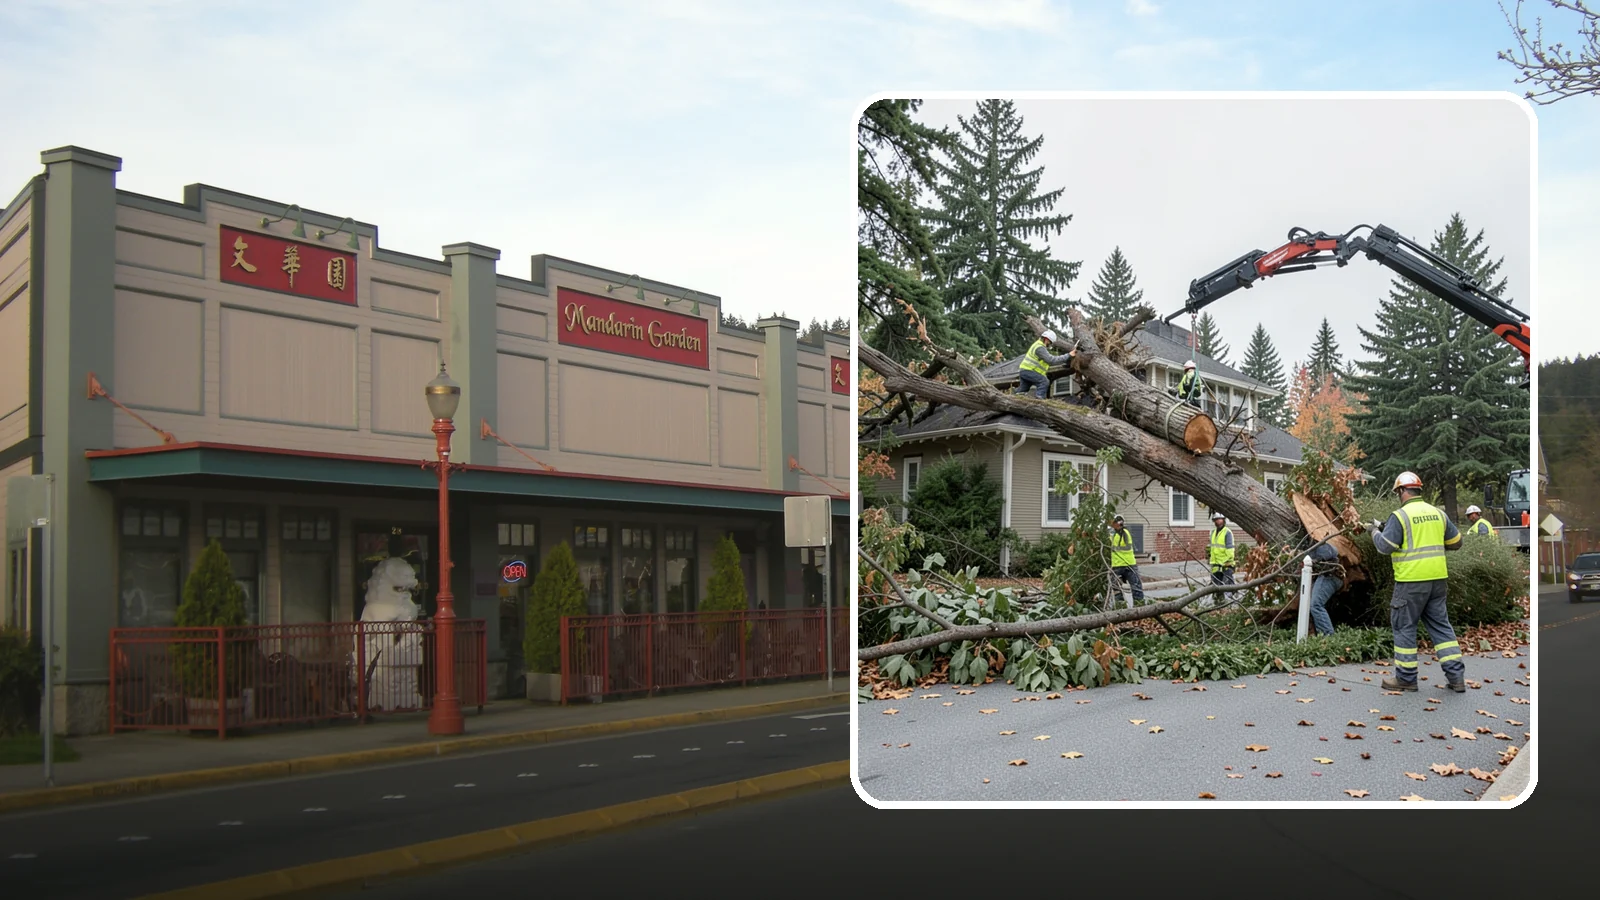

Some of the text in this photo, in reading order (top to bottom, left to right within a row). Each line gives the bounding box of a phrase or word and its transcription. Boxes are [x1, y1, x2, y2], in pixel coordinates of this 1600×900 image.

[230, 235, 346, 291] 文華園
[564, 302, 702, 352] Mandarin Garden
[503, 565, 527, 578] OPEN
